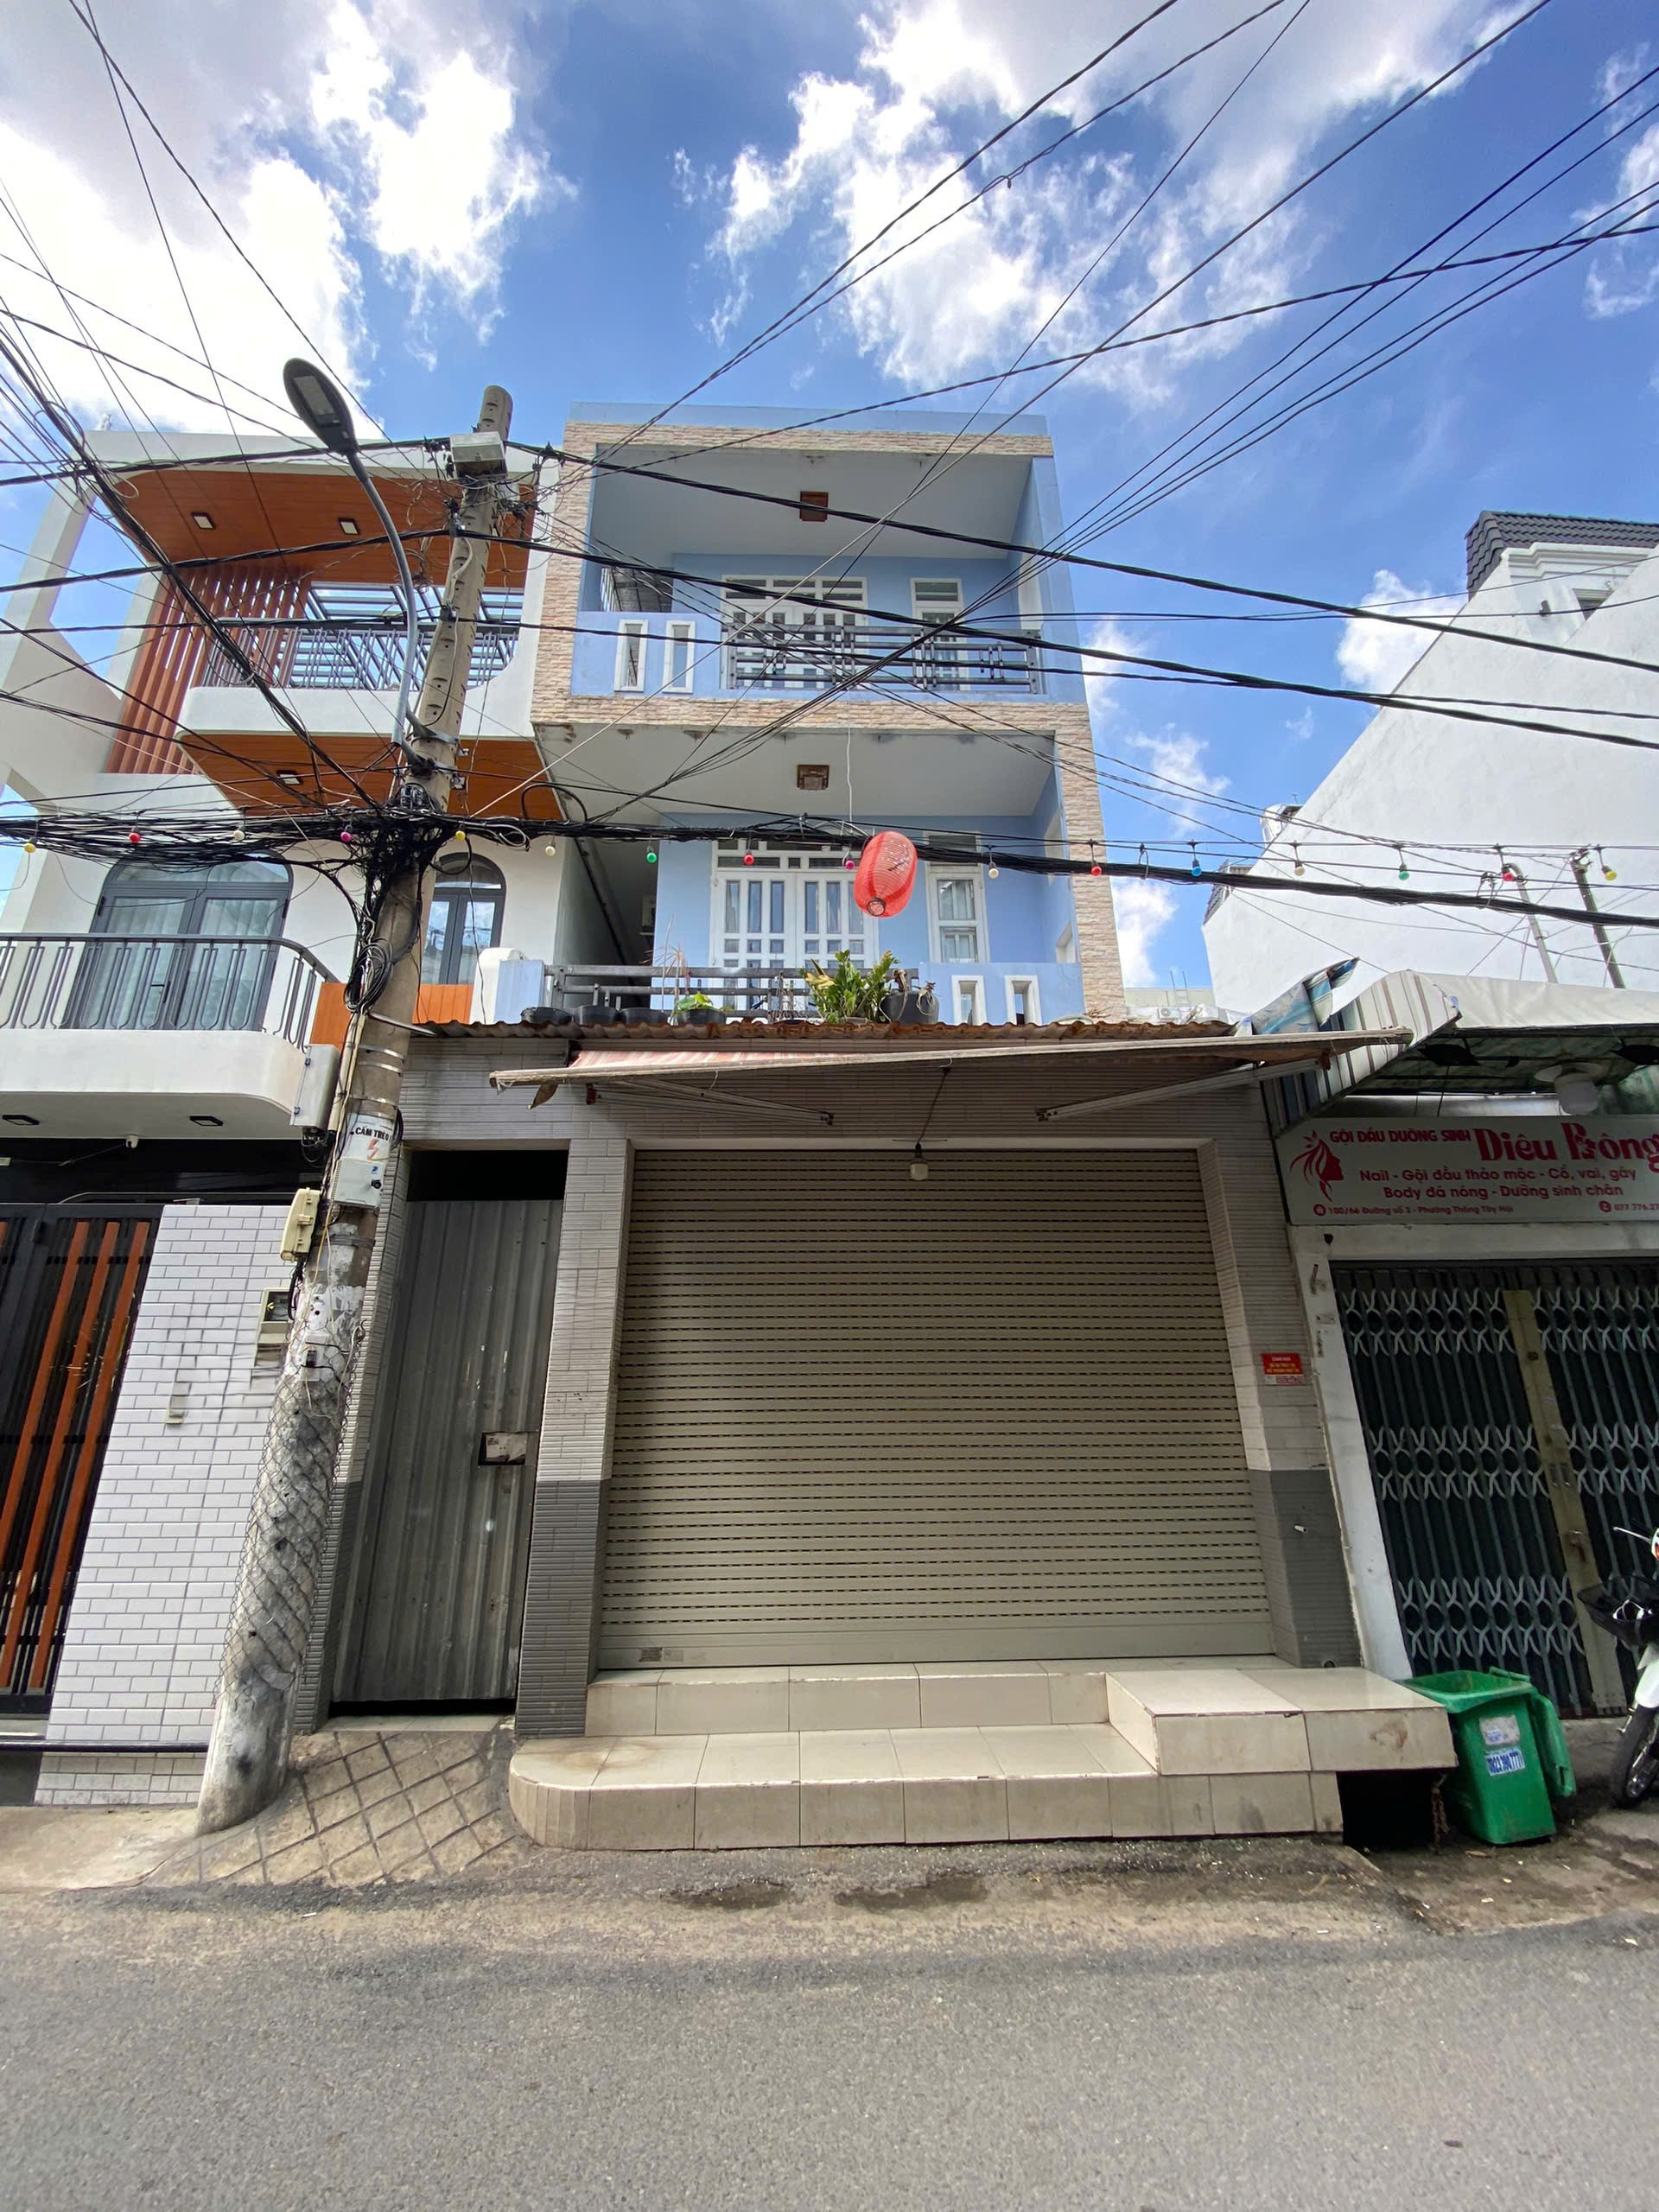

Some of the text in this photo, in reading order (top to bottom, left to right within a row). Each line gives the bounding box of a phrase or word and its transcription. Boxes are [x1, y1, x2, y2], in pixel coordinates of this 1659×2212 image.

[1359, 1169, 1389, 1181] Nail
[1382, 1186, 1421, 1200] Body
[1553, 1185, 1583, 1197] sinh
